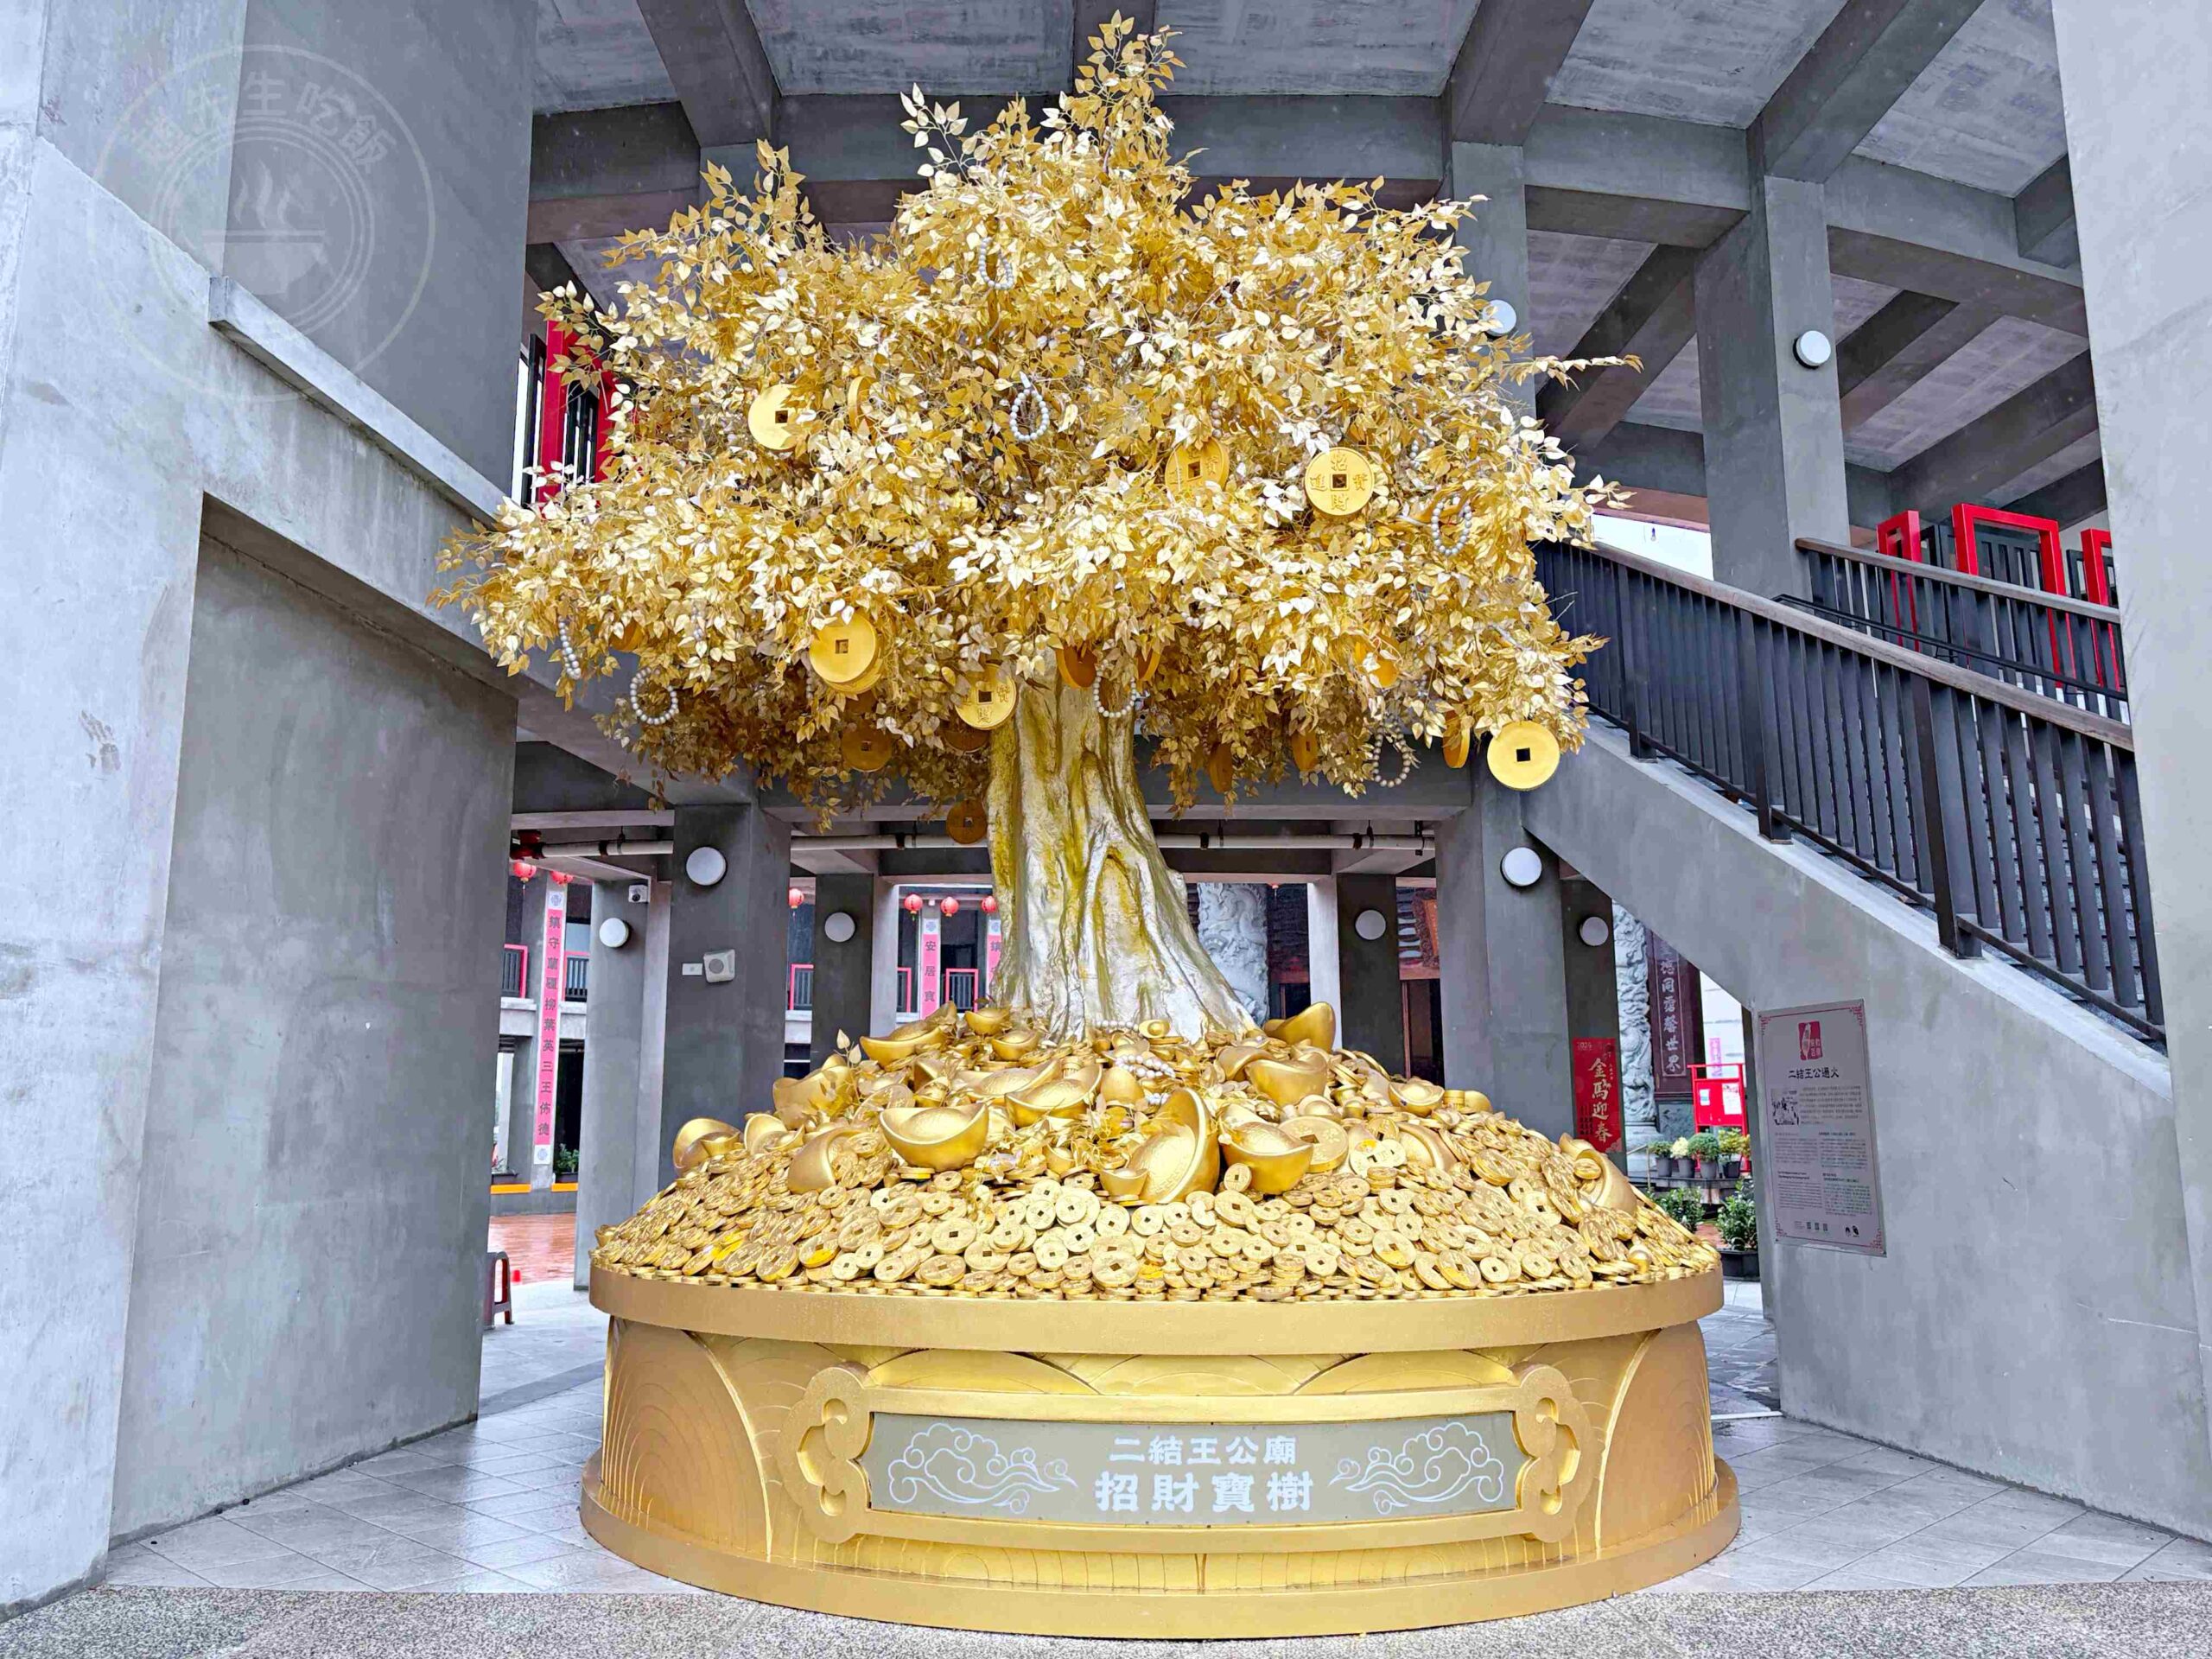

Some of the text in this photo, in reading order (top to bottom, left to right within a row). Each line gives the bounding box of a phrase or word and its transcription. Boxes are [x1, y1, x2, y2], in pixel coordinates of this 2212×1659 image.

[1109, 1434, 1296, 1465] 二結王公廟
[1094, 1471, 1313, 1512] 招財寶樹
